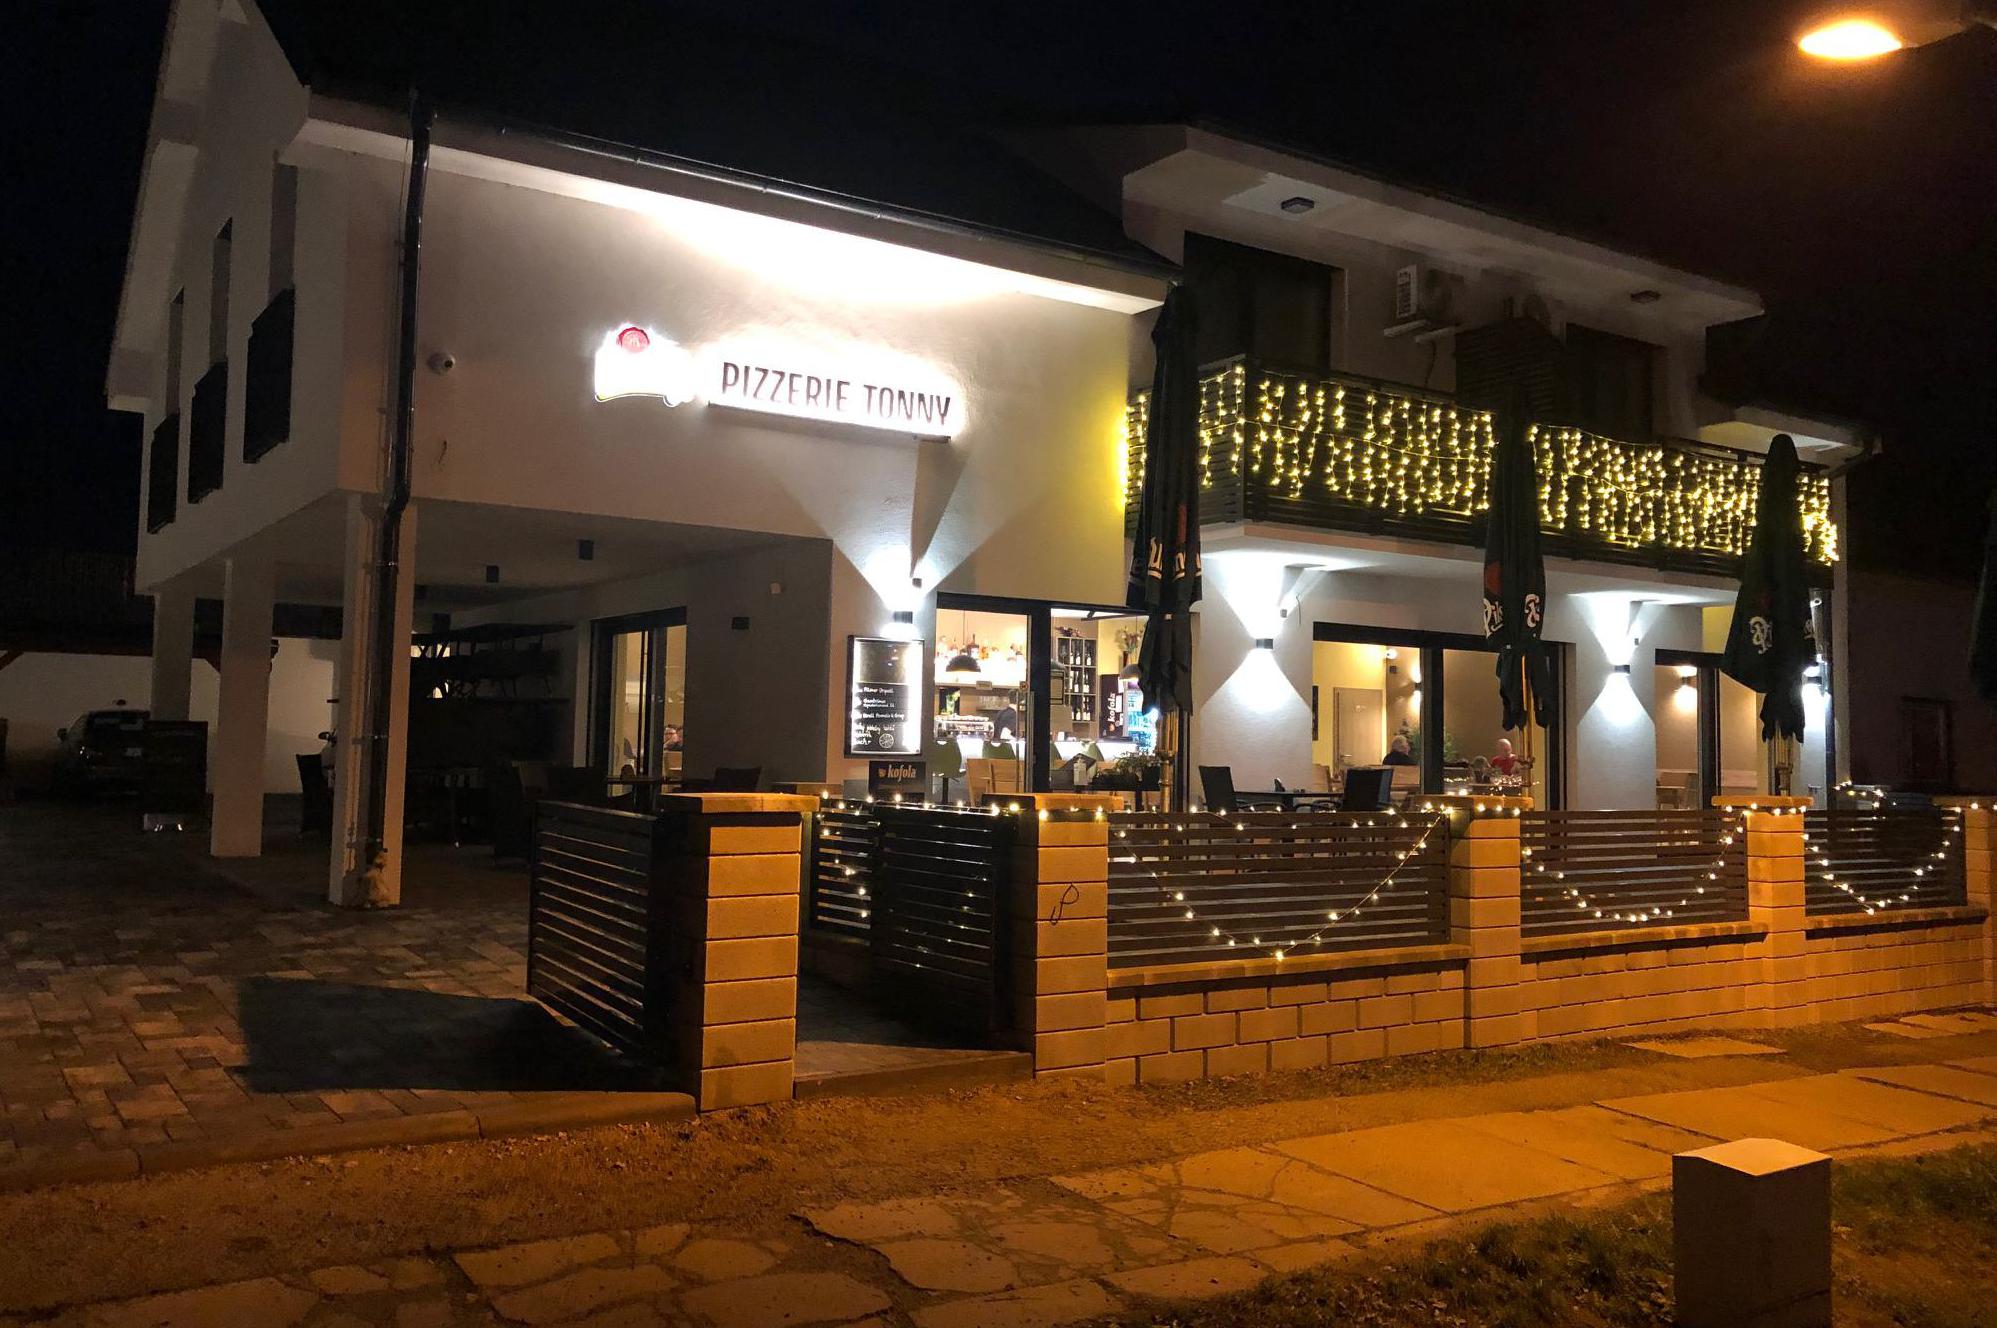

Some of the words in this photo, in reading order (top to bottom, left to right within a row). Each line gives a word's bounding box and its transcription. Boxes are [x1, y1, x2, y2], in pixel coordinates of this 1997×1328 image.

[721, 361, 851, 412] PIZZERIE
[863, 384, 951, 425] TONNY
[887, 764, 916, 782] kofola
